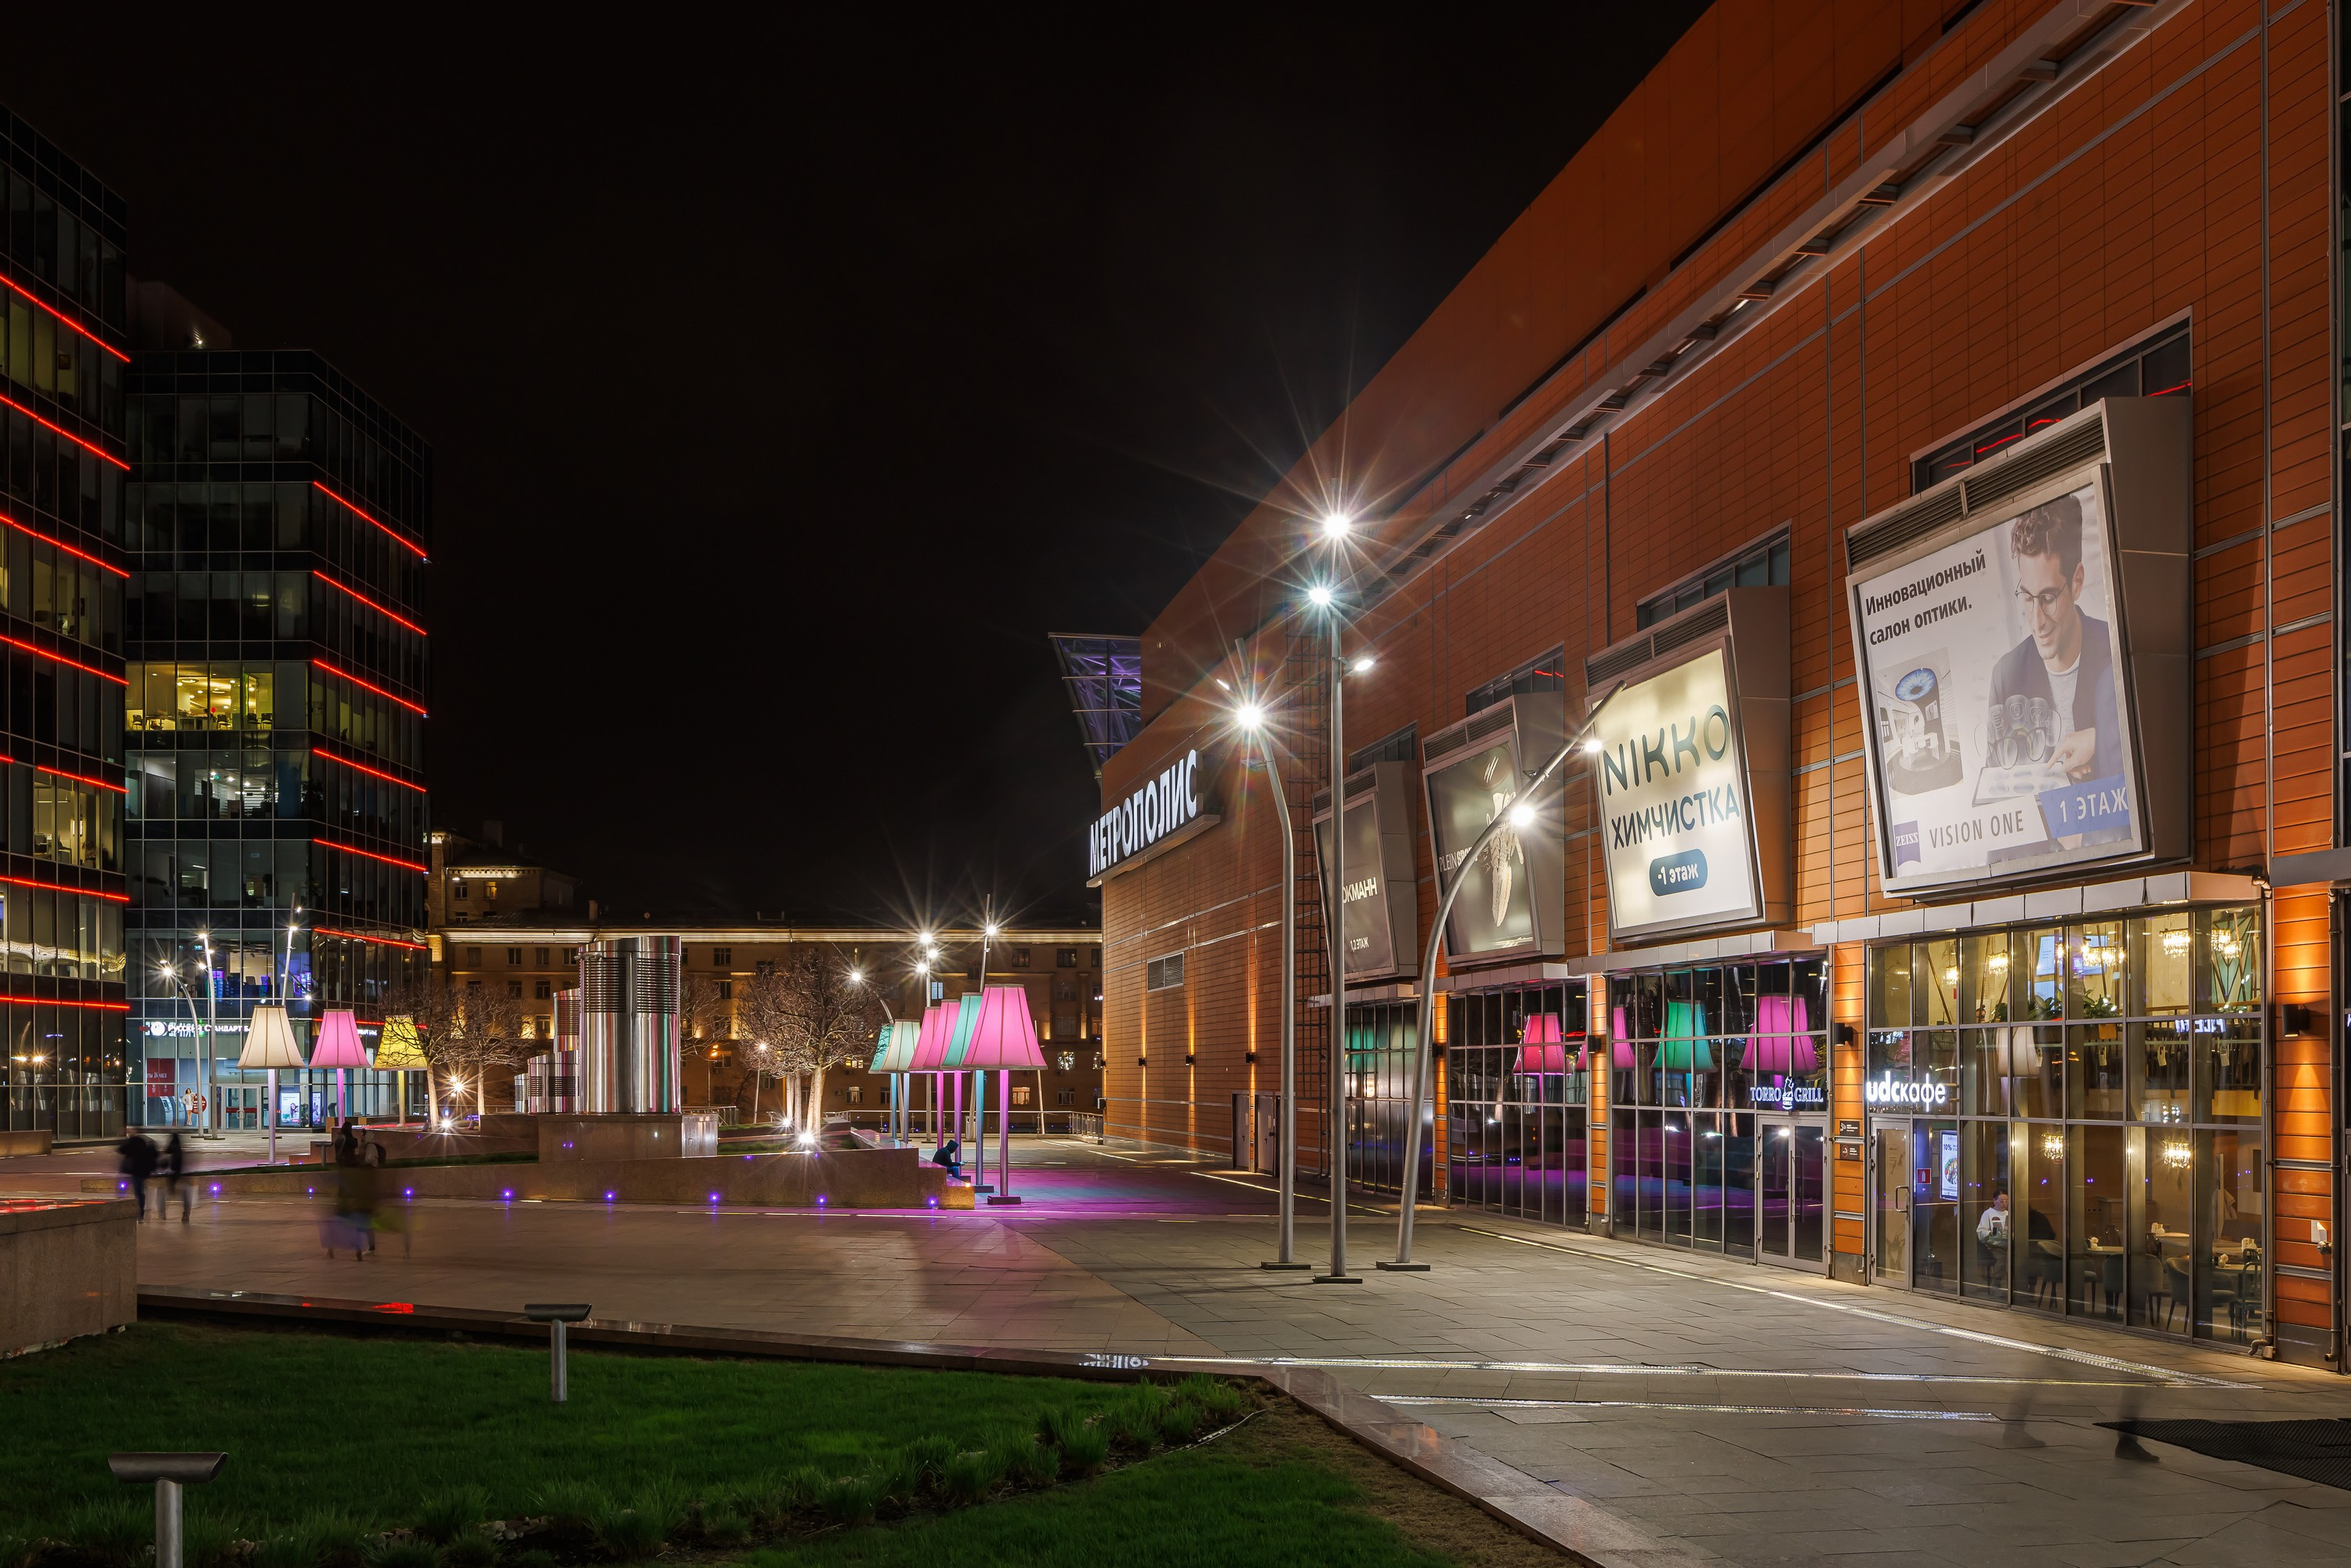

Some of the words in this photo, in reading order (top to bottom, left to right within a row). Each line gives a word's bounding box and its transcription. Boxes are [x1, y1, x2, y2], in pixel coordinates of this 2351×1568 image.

[1865, 549, 1986, 616] Инновационный
[1870, 618, 1911, 646] салон
[1914, 596, 1972, 628] оптики.
[1603, 704, 1730, 796] NIKKO
[1089, 748, 1197, 878] МЕТРОПОЛИС
[1611, 783, 1740, 850] ХИМЧИСТКА
[2059, 800, 2067, 823] 1
[2077, 787, 2129, 820] ЭТАЖ
[1895, 832, 1919, 846] ZEISS
[1929, 818, 1983, 849] VISION
[1990, 809, 2024, 837] ONE
[1668, 863, 1699, 884] этаж
[1750, 1087, 1782, 1102] TORRO
[1794, 1087, 1824, 1103] GRILL
